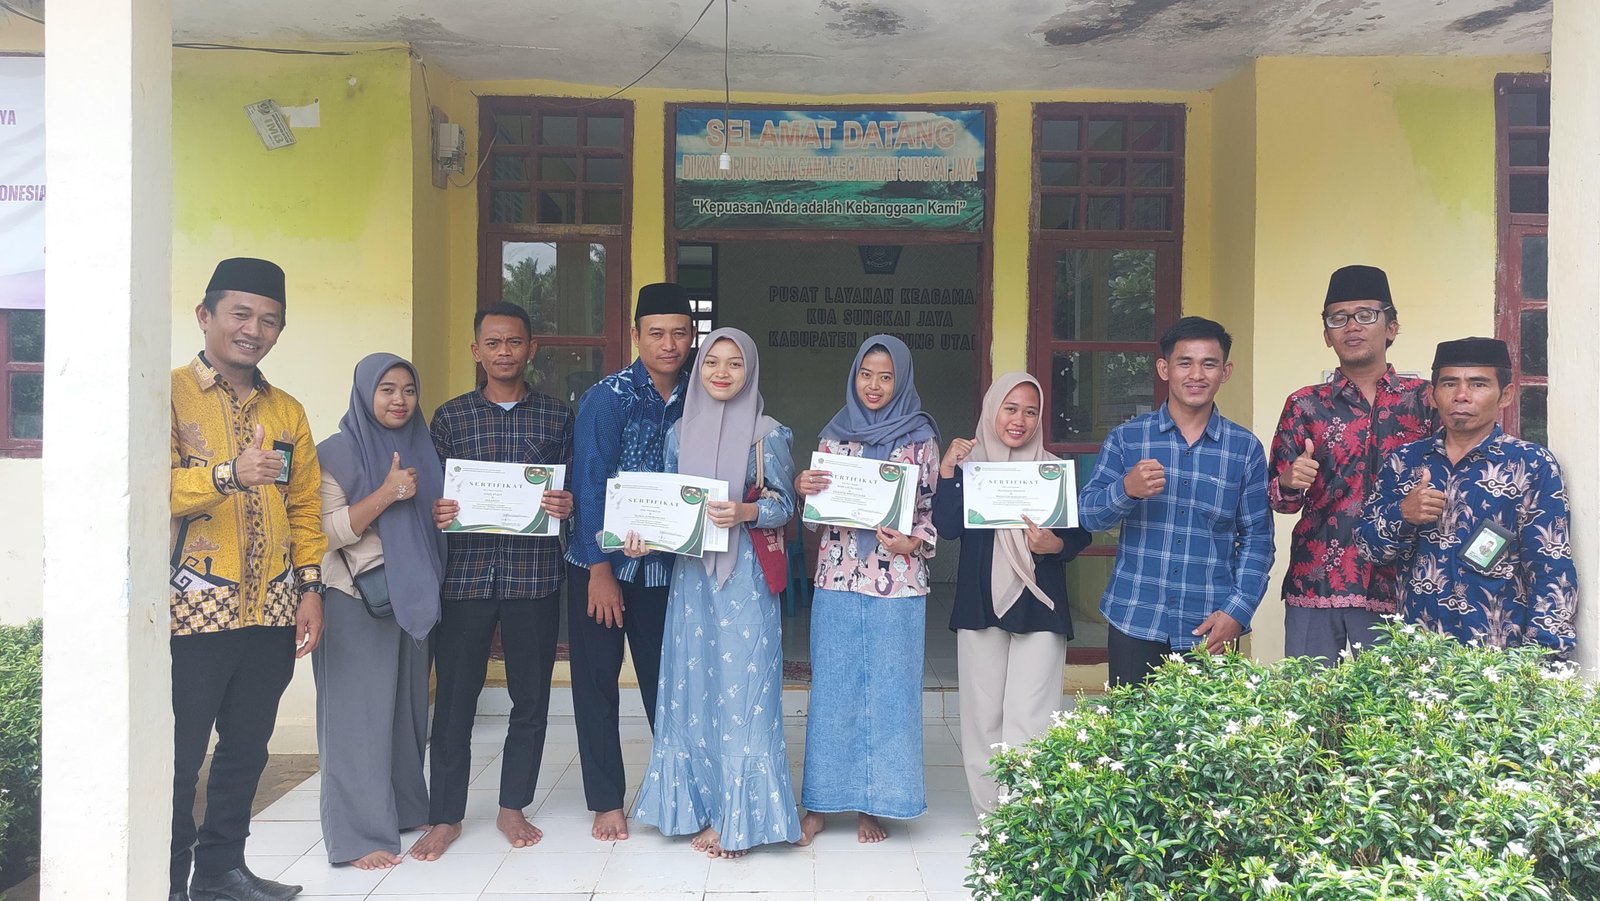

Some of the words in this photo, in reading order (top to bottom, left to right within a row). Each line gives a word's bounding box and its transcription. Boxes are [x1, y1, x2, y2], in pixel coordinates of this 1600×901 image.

[705, 118, 837, 149] SELAMAT
[843, 120, 955, 150] DATANG
[682, 154, 694, 180] DI
[743, 155, 788, 181] URUSAN
[788, 155, 830, 181] AGAMA
[831, 155, 898, 181] KECAMATAN
[898, 155, 947, 182] SUNGKAI
[948, 155, 978, 182] JAYA
[763, 199, 798, 215] Anda
[801, 199, 842, 215] adalah
[846, 200, 924, 217] Kebanggaan
[769, 285, 819, 303] PUSAT
[824, 286, 894, 304] LAYANAN
[806, 308, 837, 325] KUA
[843, 309, 911, 327] SUNGKAI
[916, 310, 954, 327] JAYA
[768, 330, 857, 348] KABUPATEN
[469, 481, 524, 489] SERTIFIKAT
[628, 498, 680, 508] SERTIFIKAT
